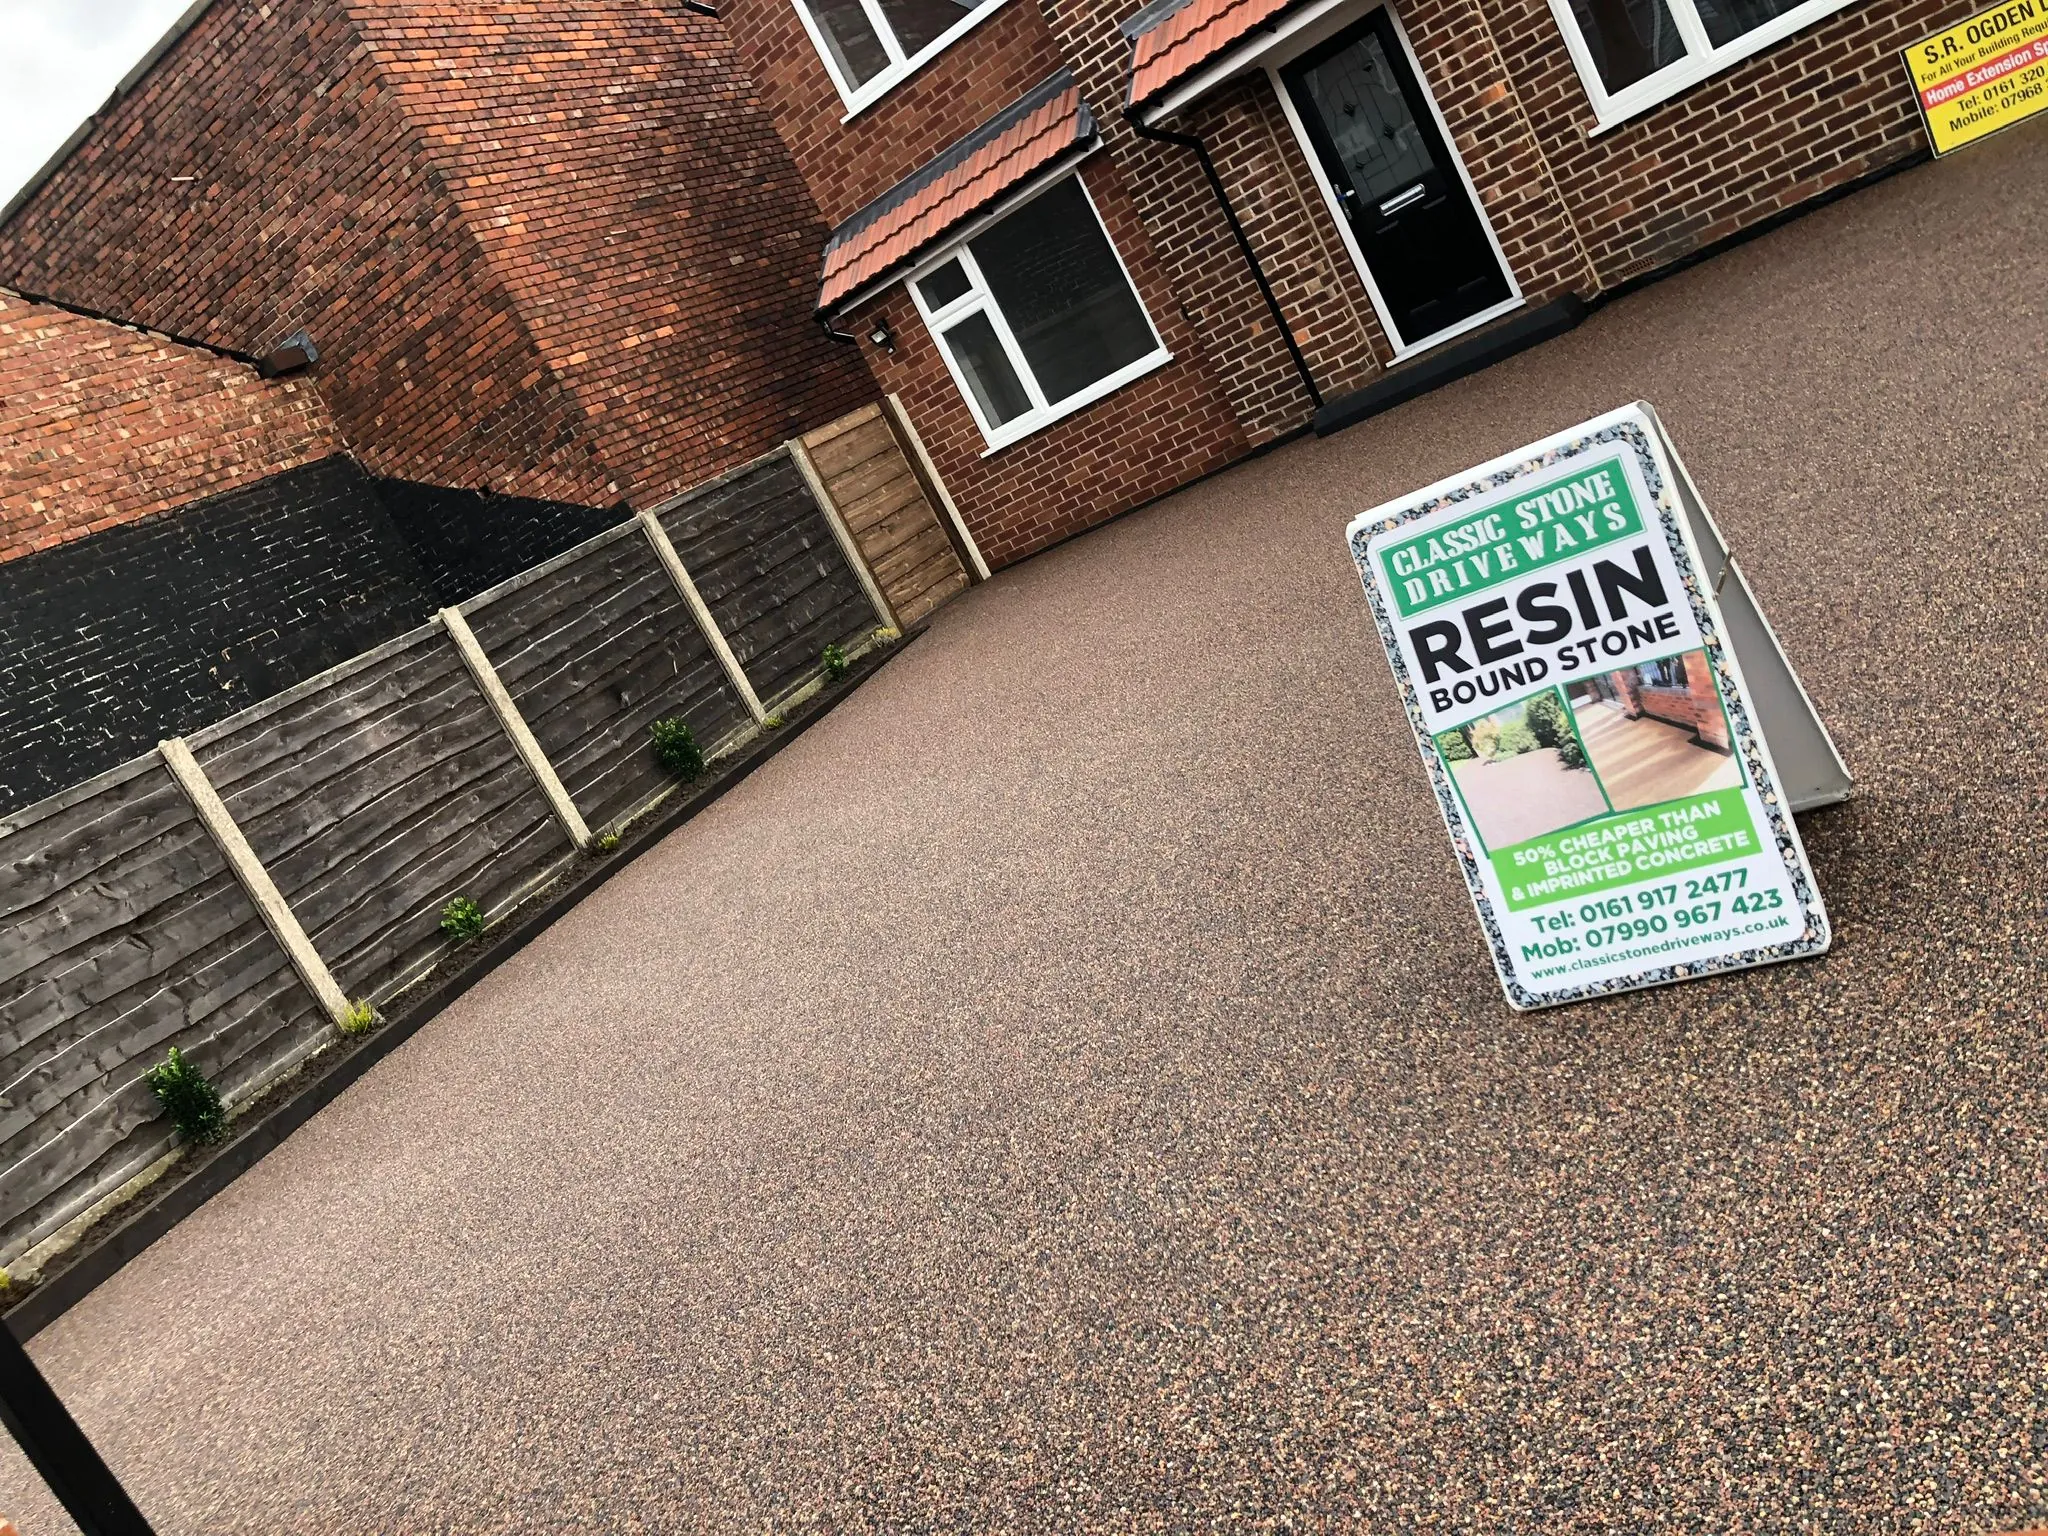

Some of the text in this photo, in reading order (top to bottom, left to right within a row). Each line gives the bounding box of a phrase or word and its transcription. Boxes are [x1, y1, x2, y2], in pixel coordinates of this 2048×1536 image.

[1921, 19, 2048, 83] For All Your Building Requ
[1924, 37, 1964, 64] S.R.
[1966, 1, 2035, 44] OGDEN
[1926, 78, 1965, 104] Home
[1966, 50, 2032, 86] Extension
[1950, 82, 2043, 131] Mobile: 07968
[1957, 66, 2045, 112] Tel: 0161 320
[1390, 470, 1616, 577] CLASSIC STONE
[1403, 502, 1627, 607] DRIVEWAYS
[1408, 544, 1670, 685] RESIN
[1429, 611, 1680, 714] BOUND STONE
[1511, 830, 1750, 901] & IMPRINTED CONCRETE
[1513, 800, 1721, 867] 50% CHEAPER THAN
[1545, 825, 1699, 876] BLOCK PAVING
[1521, 888, 1783, 963] Mob: 07990 967 423
[1531, 868, 1749, 934] Tel: 0161 917 2477
[1531, 916, 1789, 981] www.classicstonedriveways.co.uk
